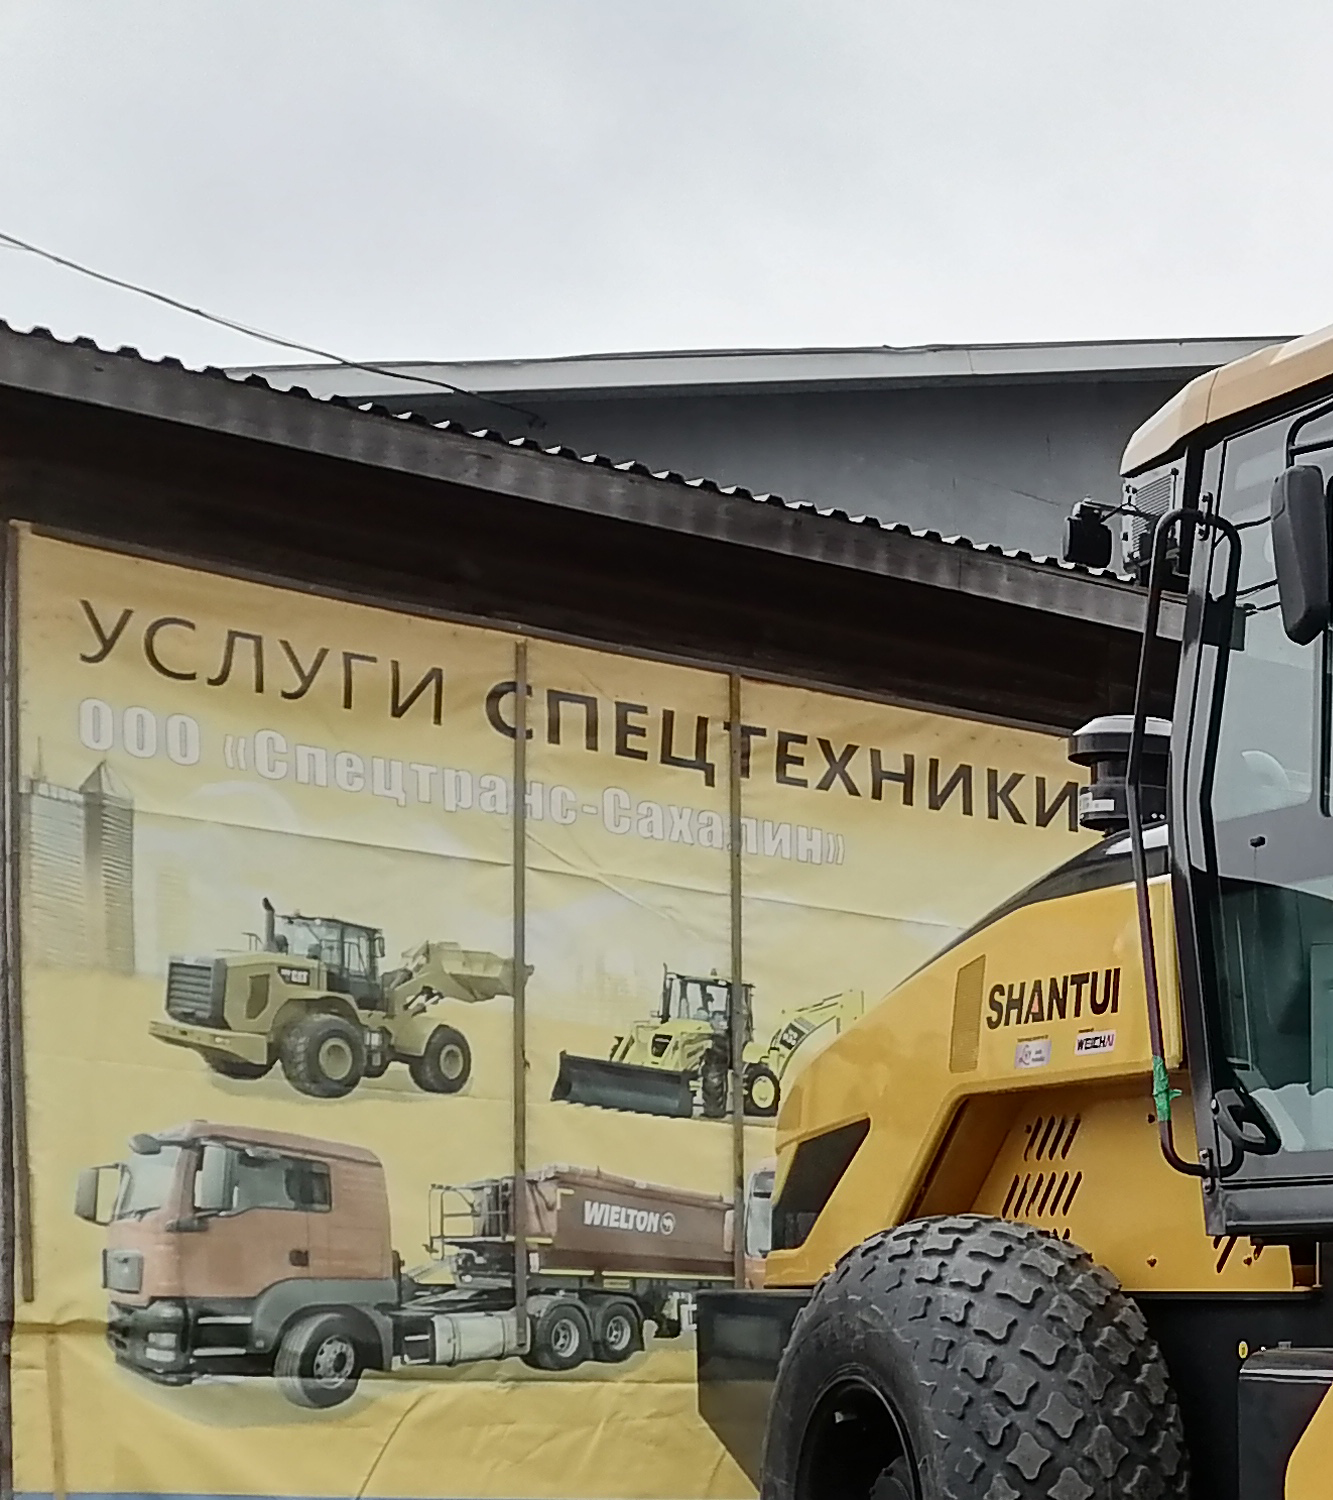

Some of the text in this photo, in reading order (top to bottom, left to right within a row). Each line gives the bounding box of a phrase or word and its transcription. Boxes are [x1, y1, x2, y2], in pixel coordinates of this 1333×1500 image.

[78, 697, 200, 766] ООО
[79, 599, 1079, 833] УСЛУГИ СПЕЦТЕХНИКИ
[986, 967, 1121, 1030] SHANTUI
[584, 1200, 660, 1233] WIELTON
